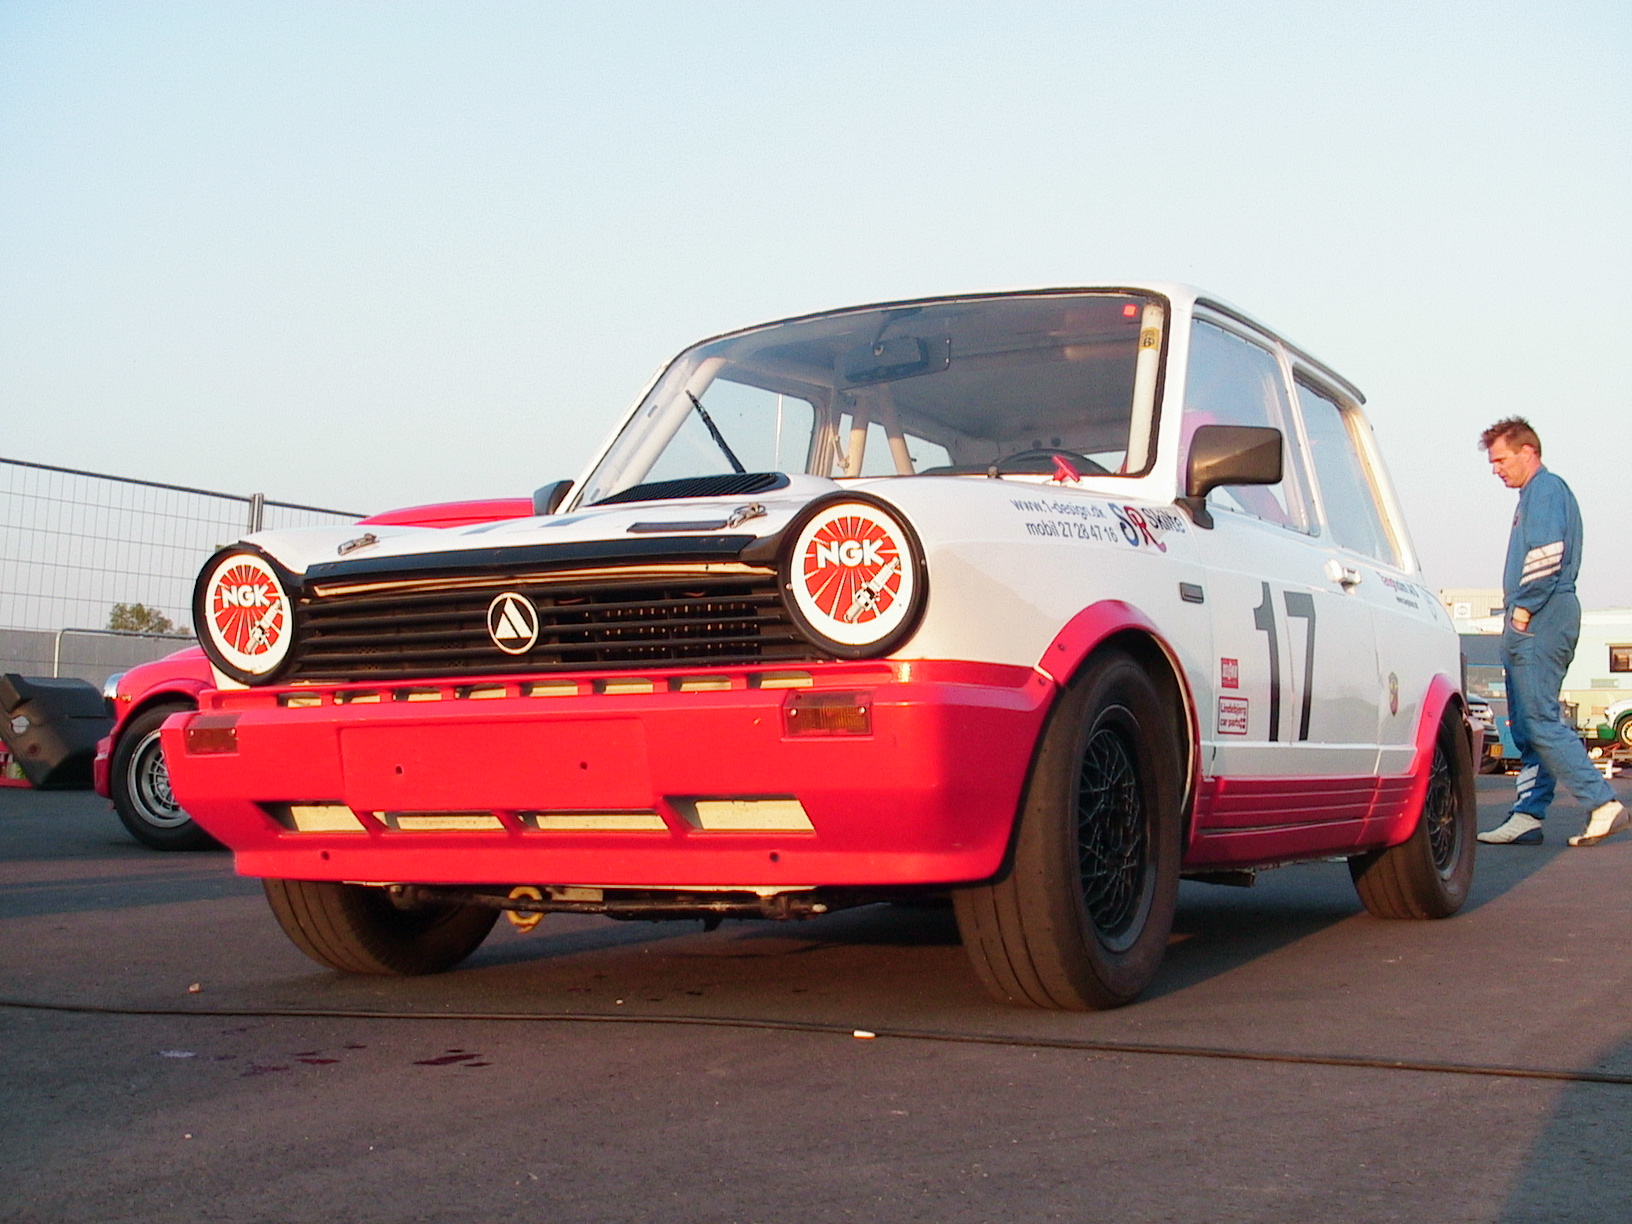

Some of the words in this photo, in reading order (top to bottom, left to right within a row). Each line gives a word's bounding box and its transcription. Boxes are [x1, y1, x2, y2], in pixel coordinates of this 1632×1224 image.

[1025, 520, 1060, 537] mobil
[1058, 522, 1073, 538] 27
[1091, 524, 1103, 541] 47
[1104, 526, 1118, 543] 16
[815, 538, 884, 568] NGK
[221, 582, 271, 609] NGK
[1253, 581, 1316, 742] 17
